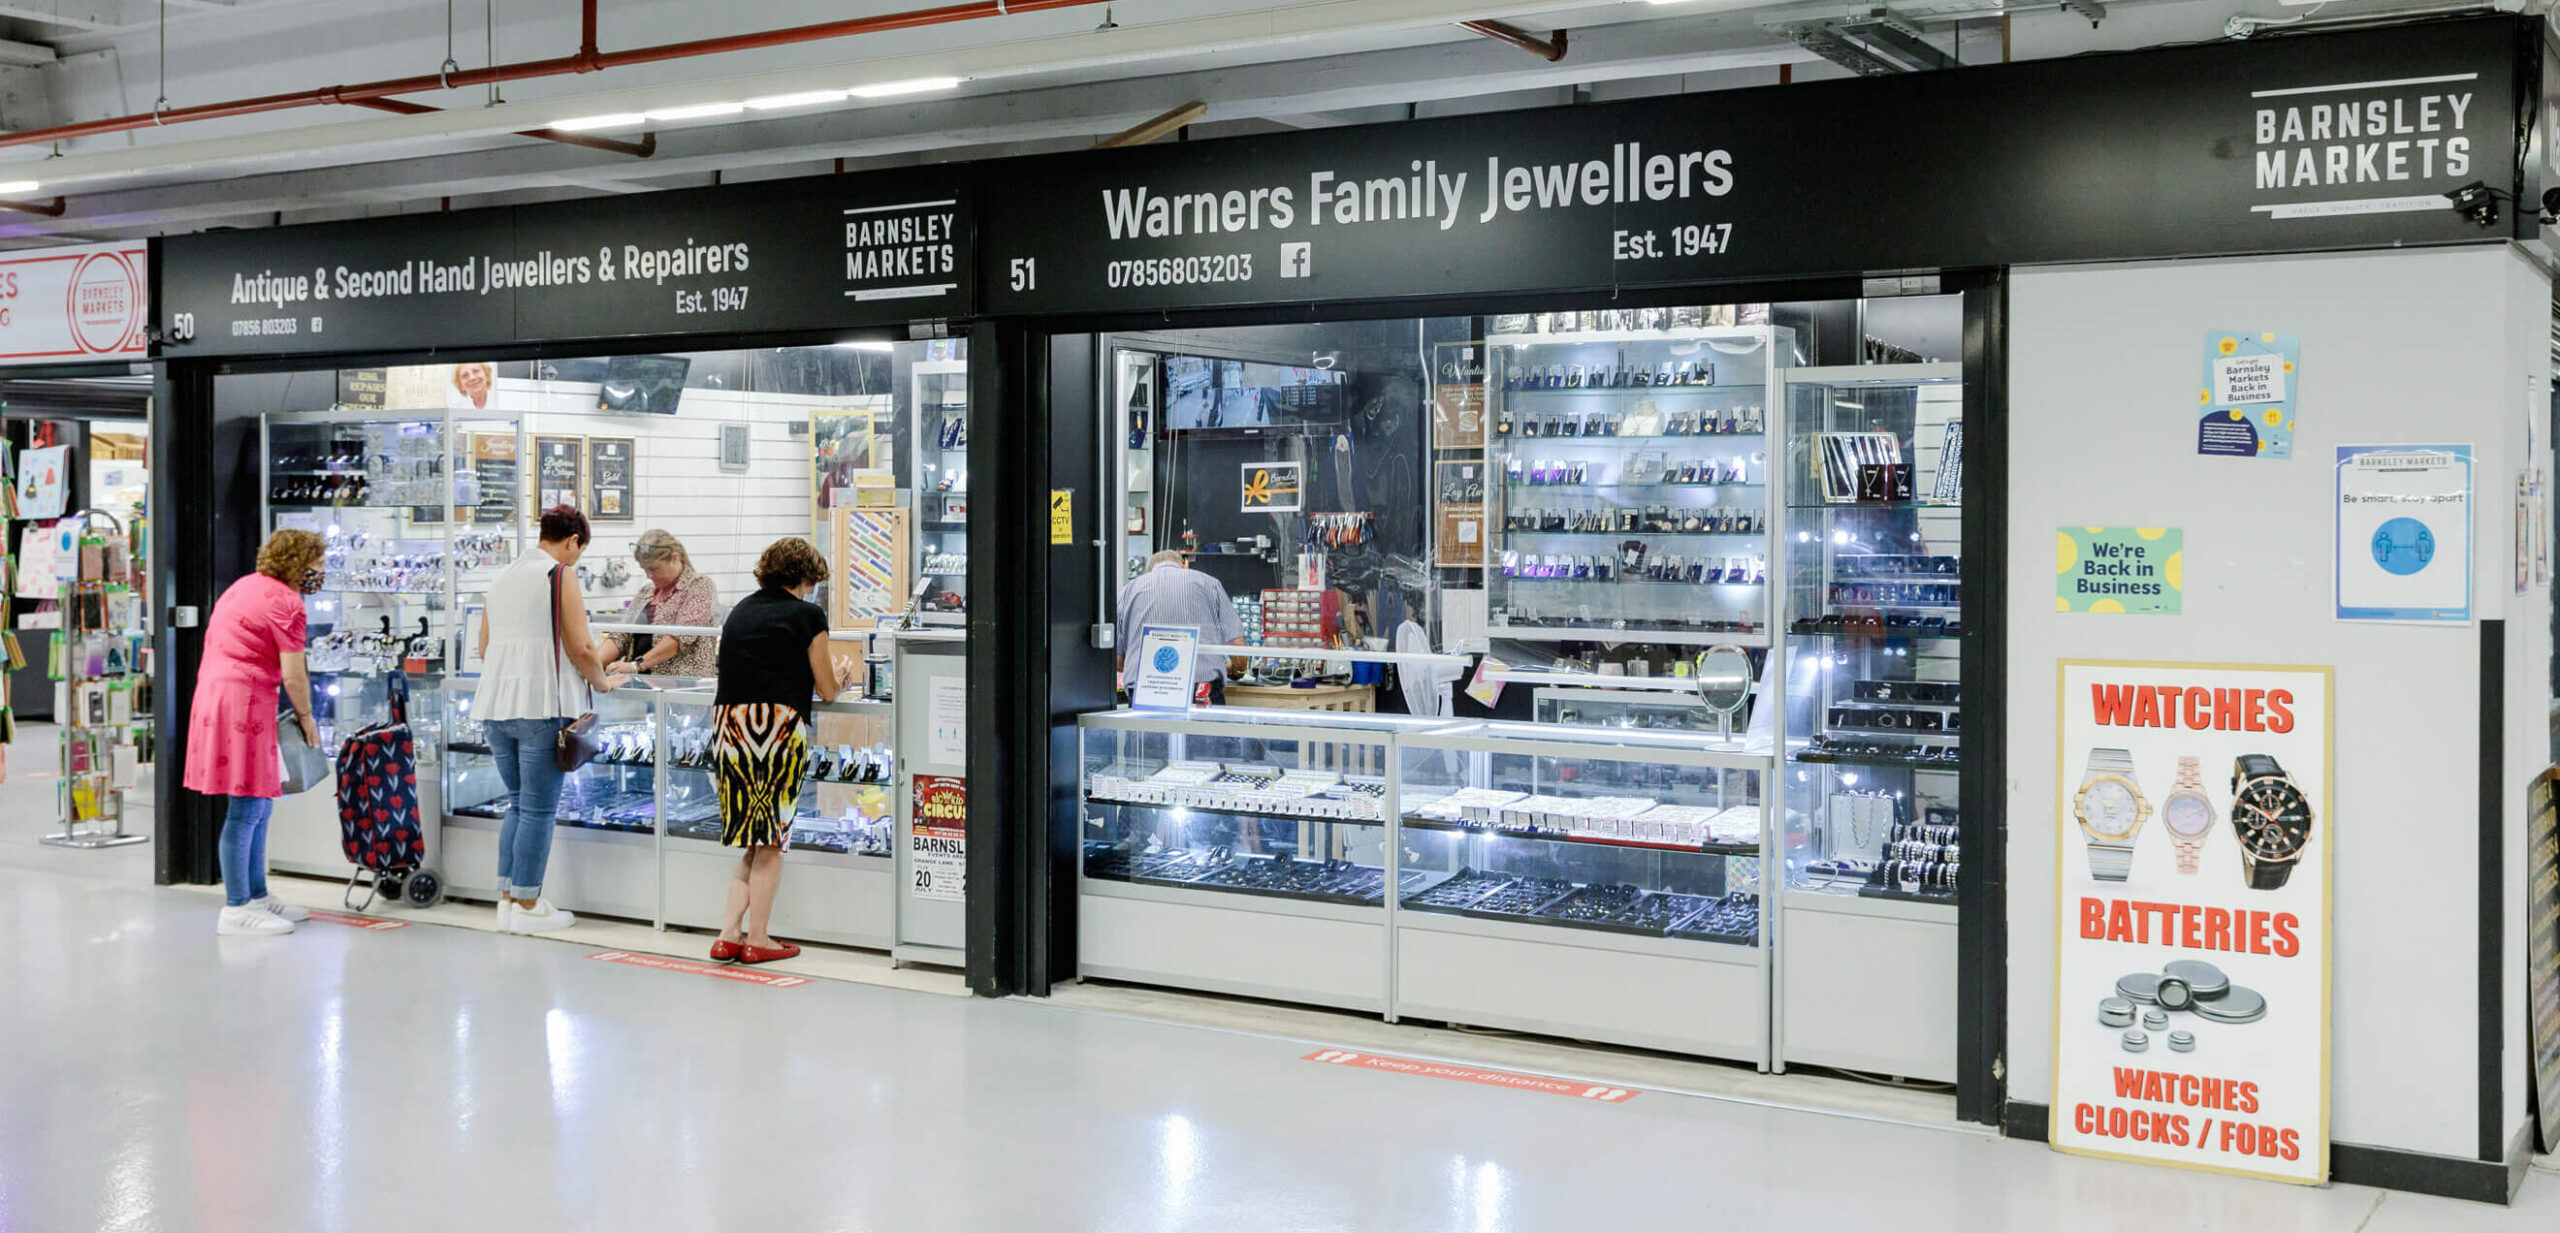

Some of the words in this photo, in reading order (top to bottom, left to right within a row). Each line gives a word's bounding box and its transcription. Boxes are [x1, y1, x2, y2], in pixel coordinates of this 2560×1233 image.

[2255, 93, 2473, 144] BARNSLEY
[2255, 136, 2470, 189] MARKETS
[1103, 184, 1295, 240] Warners
[1310, 159, 1467, 230] Family
[1480, 141, 1734, 224] Jewellers
[845, 213, 954, 248] BARNSLEY
[1613, 229, 1663, 260] Est.
[1671, 223, 1733, 257] 1947
[231, 269, 309, 309] Antique
[314, 267, 330, 300] &
[334, 260, 413, 299] Second
[419, 256, 475, 293] Hand
[480, 250, 591, 295] Jewellers
[599, 246, 616, 281] &
[623, 238, 750, 285] Repairers
[845, 244, 954, 280] MARKETS
[1010, 257, 1035, 291] 51
[1107, 252, 1253, 288] 07856803203
[83, 286, 124, 300] BARNSLEY
[676, 290, 707, 314] Est.
[711, 286, 750, 312] 1947
[83, 300, 124, 315] MARKETS
[174, 313, 194, 340] 50
[232, 320, 261, 336] 07856
[262, 317, 297, 335] 803203
[2226, 363, 2270, 374] Barnsley
[2229, 374, 2269, 383] Markets
[2227, 392, 2271, 402] Business
[2231, 383, 2255, 393] Back
[2258, 382, 2267, 391] in
[2360, 456, 2404, 467] BARNSLEY
[2406, 456, 2448, 466] MARKETS
[2343, 493, 2358, 504] Be
[2429, 493, 2464, 505] apart
[1052, 515, 1070, 525] CCTV
[2092, 541, 2145, 558] We're
[2084, 559, 2131, 576] Back
[2136, 559, 2154, 576] in
[2076, 577, 2162, 595] Business
[2091, 683, 2294, 734] WATCHES
[914, 837, 964, 854] BARNSL
[916, 870, 931, 888] 20
[2080, 896, 2299, 958] BATTERIES
[1366, 1057, 1418, 1071] Keep
[1421, 1065, 1474, 1078] your
[1477, 1071, 1571, 1090] distance
[2113, 1066, 2259, 1114] WATCHES
[2074, 1102, 2190, 1147] CLOCKS
[2197, 1118, 2213, 1149] /
[2220, 1121, 2300, 1161] FOBS
